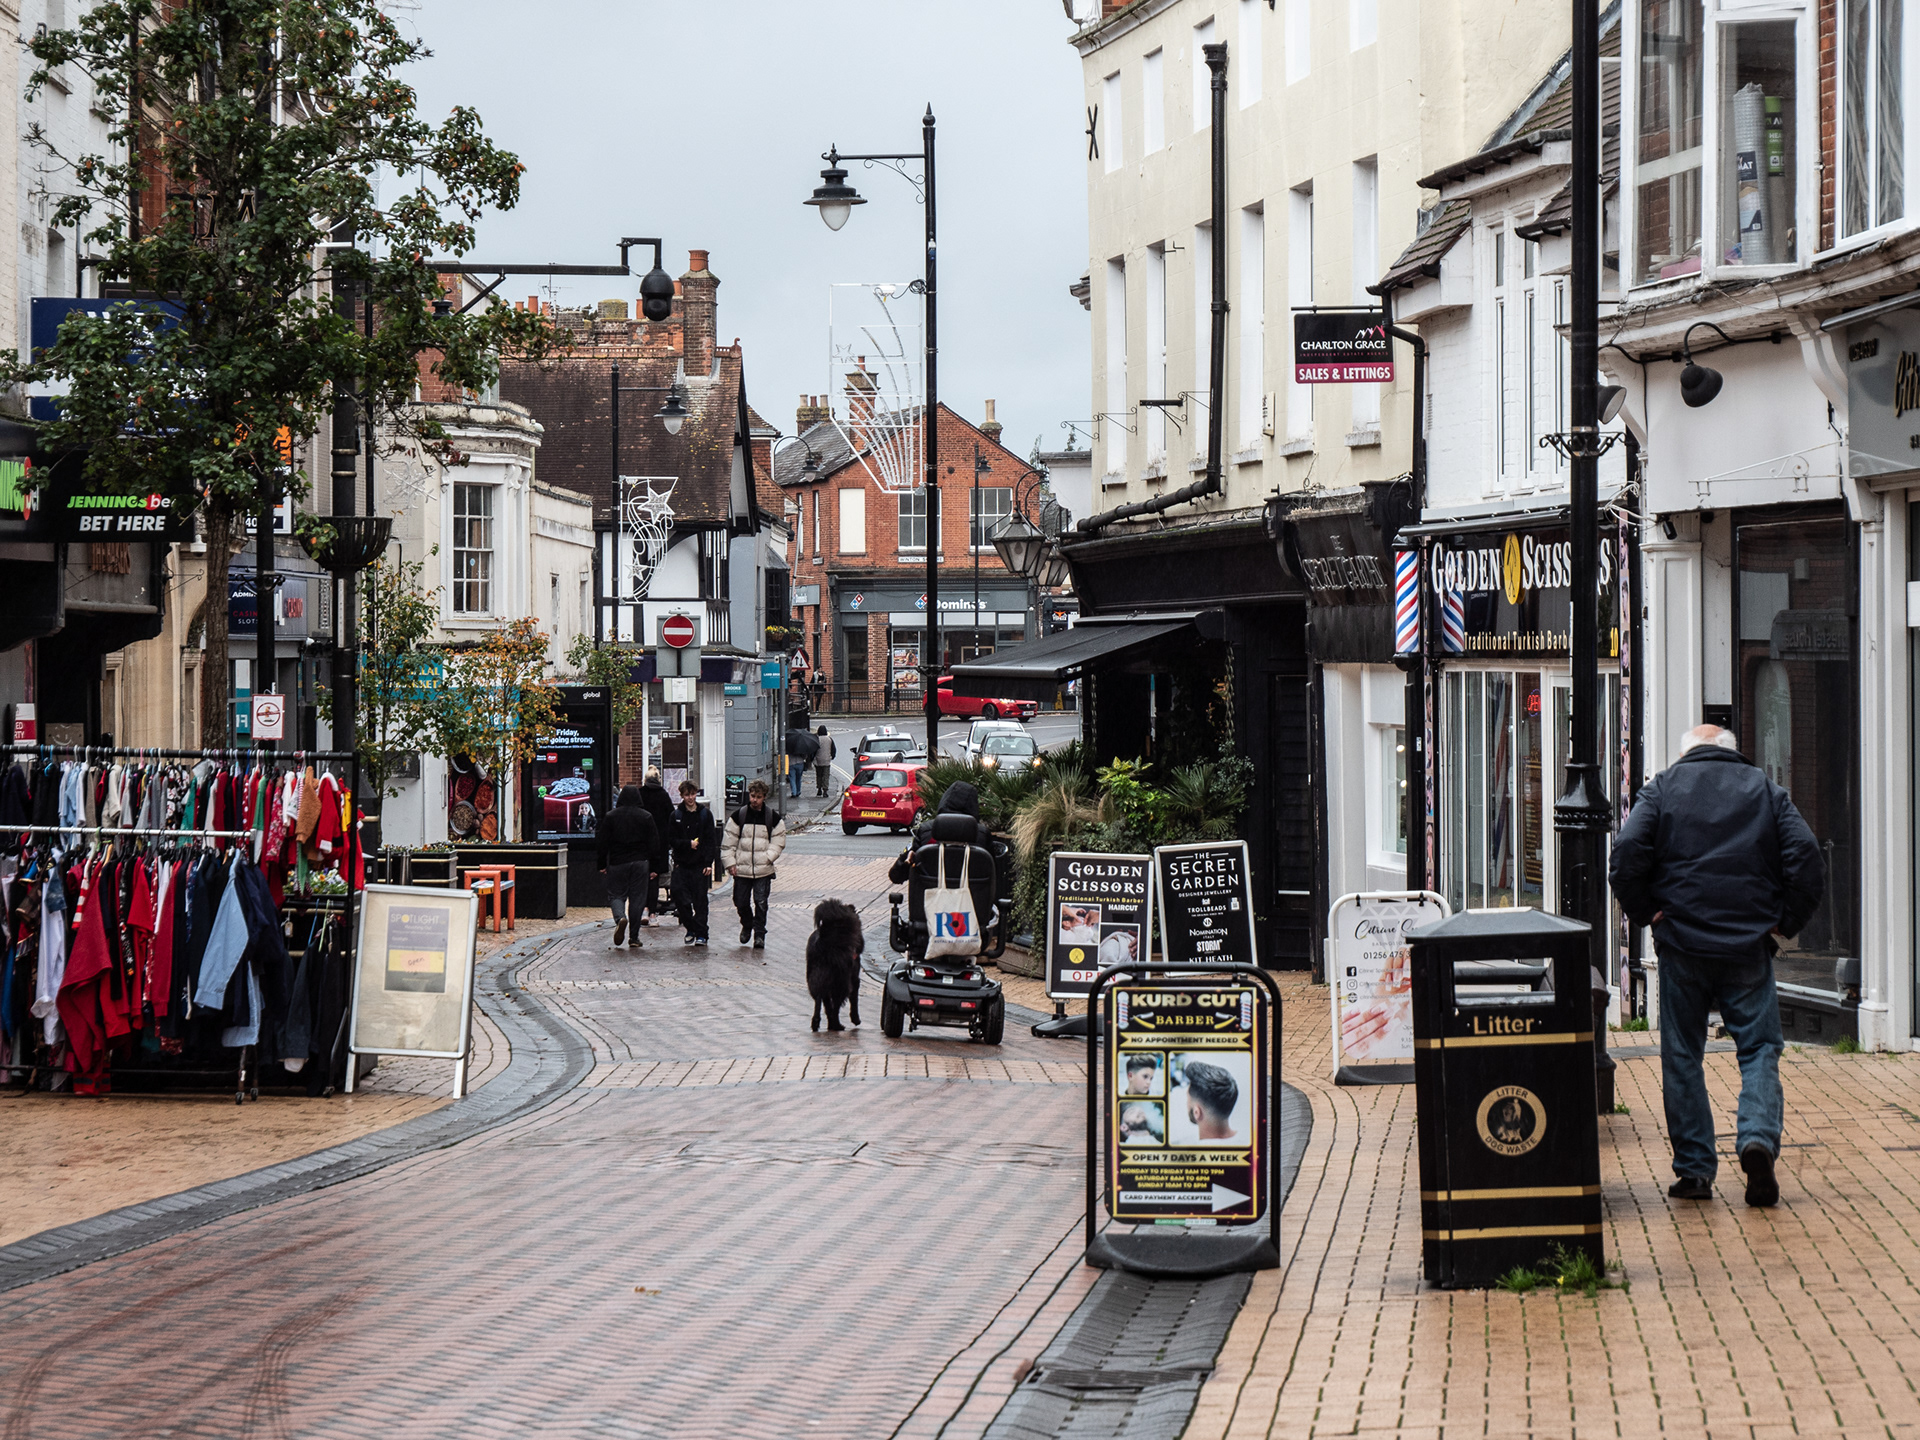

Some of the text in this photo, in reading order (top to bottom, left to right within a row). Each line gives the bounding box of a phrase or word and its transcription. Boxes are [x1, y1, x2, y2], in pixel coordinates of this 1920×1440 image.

[1301, 340, 1387, 350] CHARLTON GRACE
[1299, 367, 1391, 380] SALES & LETTINGS
[79, 515, 166, 531] BET HERE
[1431, 535, 1611, 607] GOLDEN SCISSS
[1464, 631, 1511, 650] Traditional
[1512, 631, 1545, 650] Turkish
[582, 691, 601, 700] global
[556, 728, 580, 737] Friday,
[550, 736, 570, 745] going
[570, 736, 595, 744] strong.
[1194, 852, 1210, 860] THE
[1068, 862, 1143, 878] GOLDEN
[1169, 858, 1237, 876] SECRET
[1058, 878, 1145, 895] SCISSORS
[1171, 874, 1239, 890] GARDEN
[1187, 905, 1227, 913] TROLLBEADS
[1189, 928, 1228, 936] NOMINATION
[1189, 954, 1233, 964] KIT HEATH
[1363, 950, 1404, 960] 01256 475
[1131, 993, 1240, 1007] KURD CUT
[1155, 1015, 1215, 1025] BARBER
[1473, 1015, 1535, 1035] Litter
[1495, 1087, 1529, 1099] LITTER
[1485, 1135, 1538, 1154] DOG WASTE
[1170, 1154, 1197, 1162] DAYS
[1199, 1154, 1207, 1162] A
[1209, 1154, 1240, 1162] WEEK
